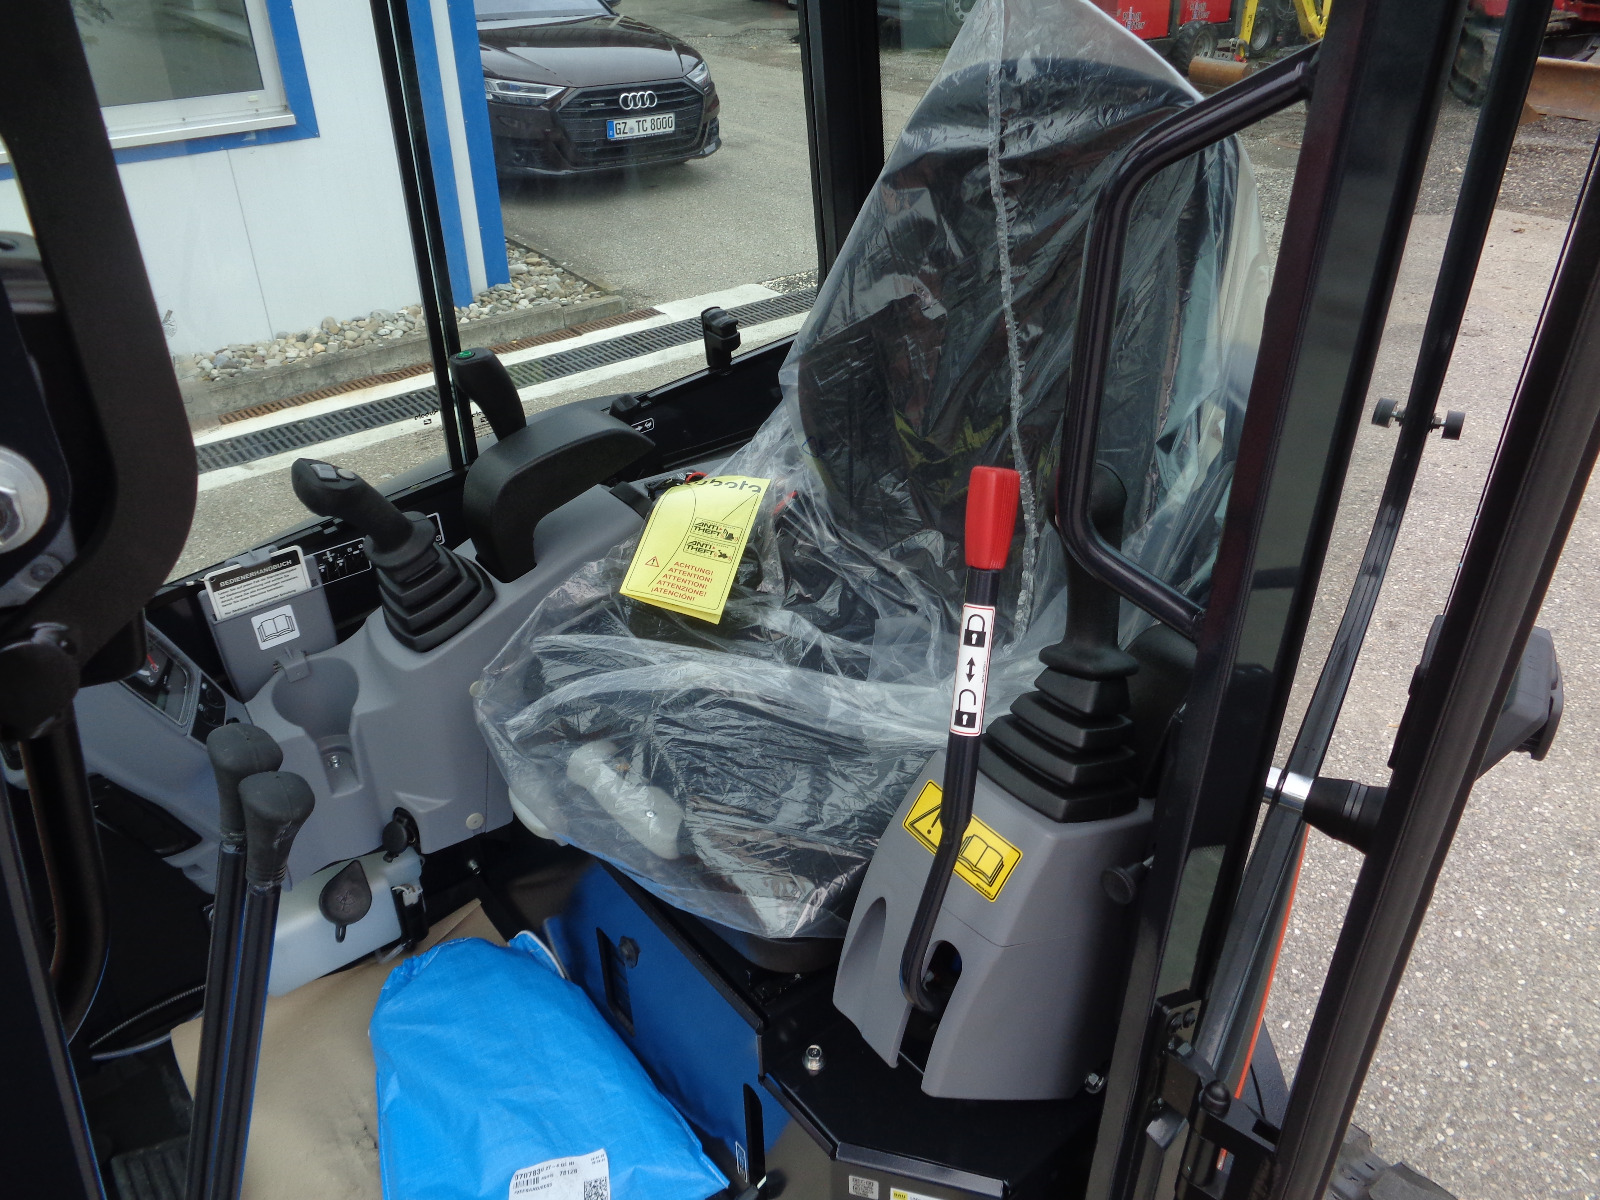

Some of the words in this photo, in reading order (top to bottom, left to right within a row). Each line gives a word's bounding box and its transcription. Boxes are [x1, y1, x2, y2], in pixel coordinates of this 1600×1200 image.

[615, 122, 628, 135] GZ
[636, 119, 648, 133] TC
[650, 116, 673, 131] 8000
[692, 478, 762, 493] ubota
[693, 525, 720, 537] THEFT
[694, 522, 719, 531] ANTI
[687, 540, 712, 550] ANTI
[687, 544, 714, 556] THEFT
[219, 559, 292, 588] BEDIENERHANDBUCH
[668, 567, 713, 584] ATTENTION!
[674, 561, 714, 576] ACHTUNG!
[656, 579, 707, 598] ATTENZIONE!
[662, 573, 708, 590] ATTENTION!
